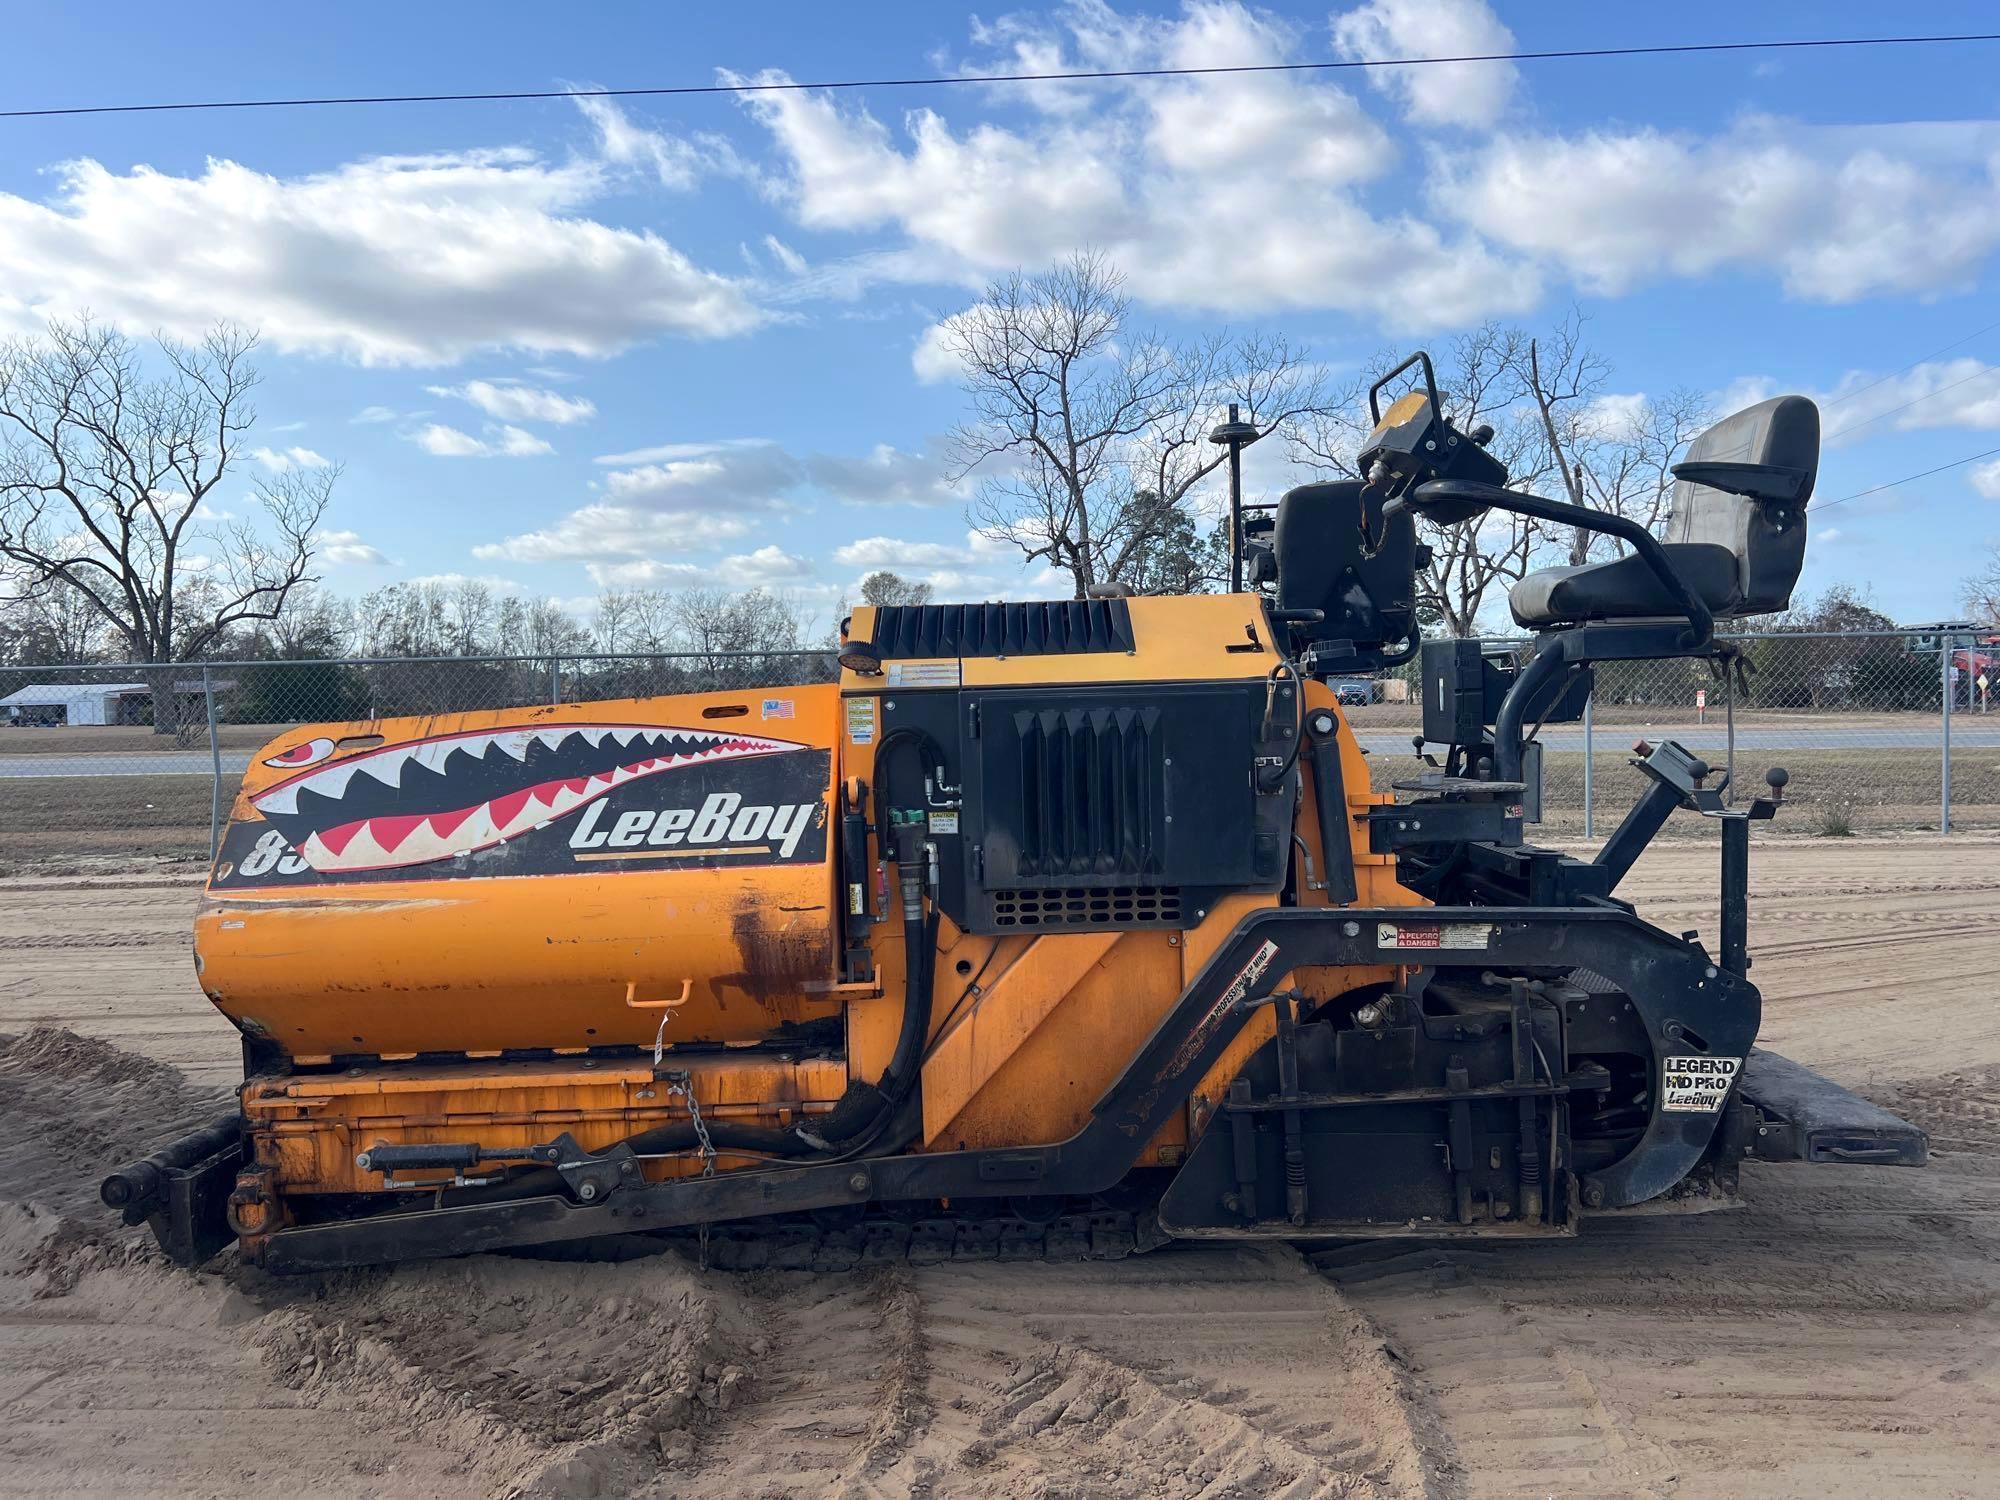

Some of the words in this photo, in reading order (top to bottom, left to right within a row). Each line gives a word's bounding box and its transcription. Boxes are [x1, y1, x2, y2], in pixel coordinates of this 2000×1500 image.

[569, 792, 815, 858] LeeBoy
[1406, 932, 1438, 940] PELIGRO
[1667, 1059, 1735, 1074] LEGEND
[1695, 1076, 1727, 1089] PRO
[1668, 1091, 1718, 1109] LeeBoy
